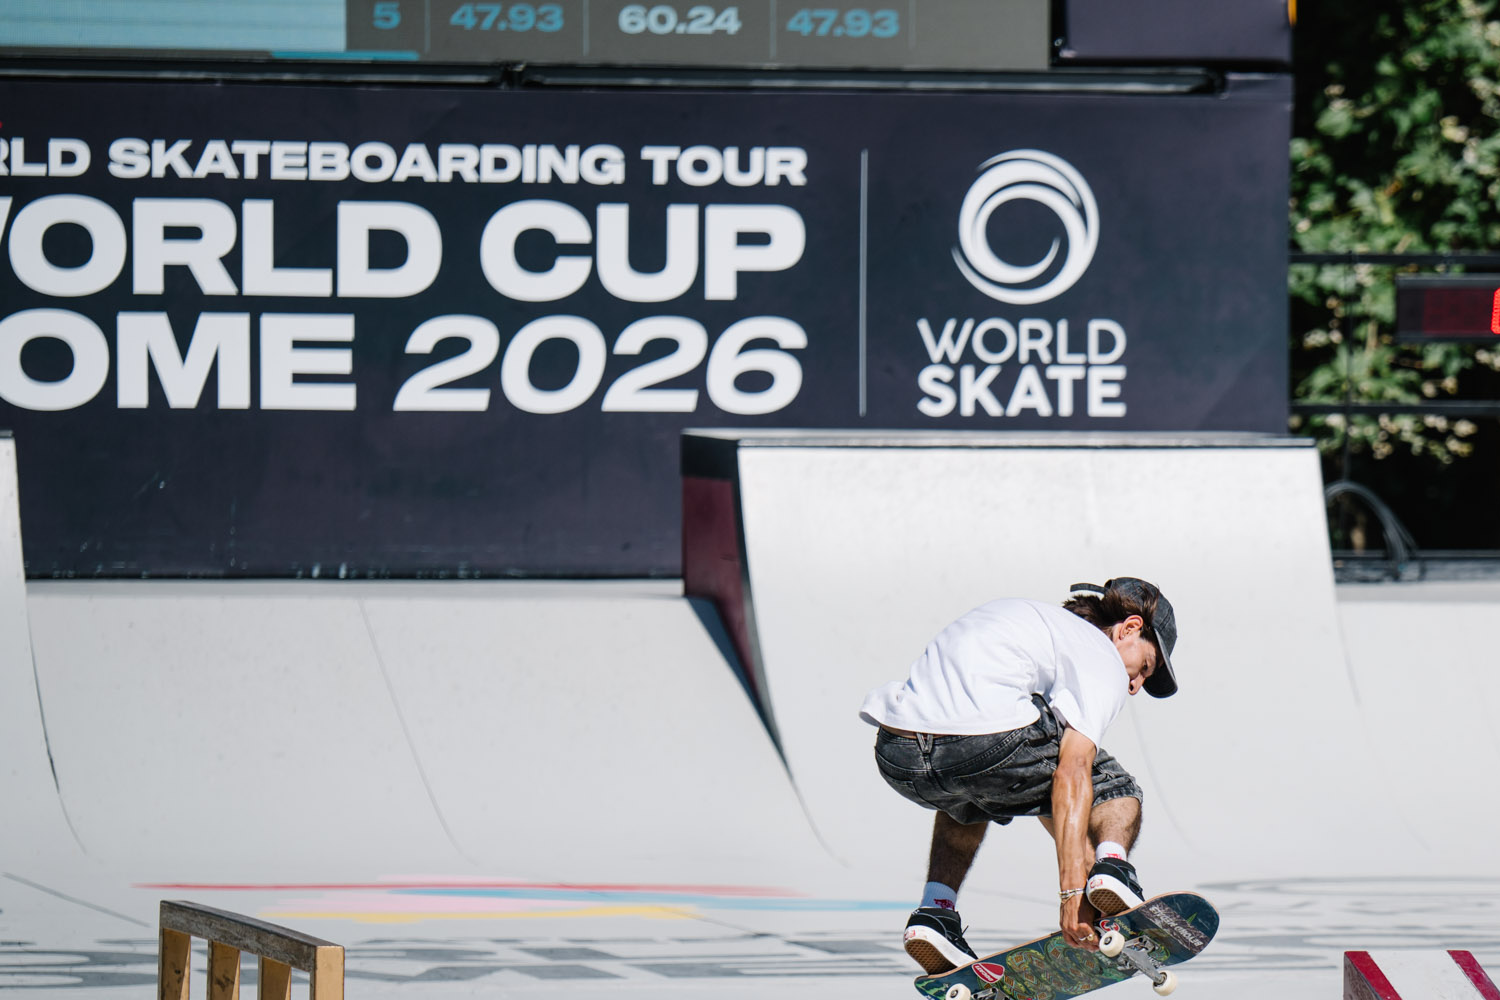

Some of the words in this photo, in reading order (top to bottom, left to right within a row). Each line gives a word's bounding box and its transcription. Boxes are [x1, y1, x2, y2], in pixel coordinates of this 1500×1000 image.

[373, 2, 402, 30] 5
[449, 3, 565, 33] 47.93
[618, 5, 742, 35] 60.24
[786, 9, 900, 38] 47.93
[0, 138, 91, 177] LD
[108, 138, 626, 186] SKATEBOARDING
[640, 145, 808, 187] TOUR
[0, 194, 443, 298] ORLD
[480, 199, 806, 303] CUP
[0, 308, 357, 411] OME
[393, 314, 808, 415] 2026
[917, 318, 1127, 364] WORLD
[917, 366, 1127, 417] SKATE
